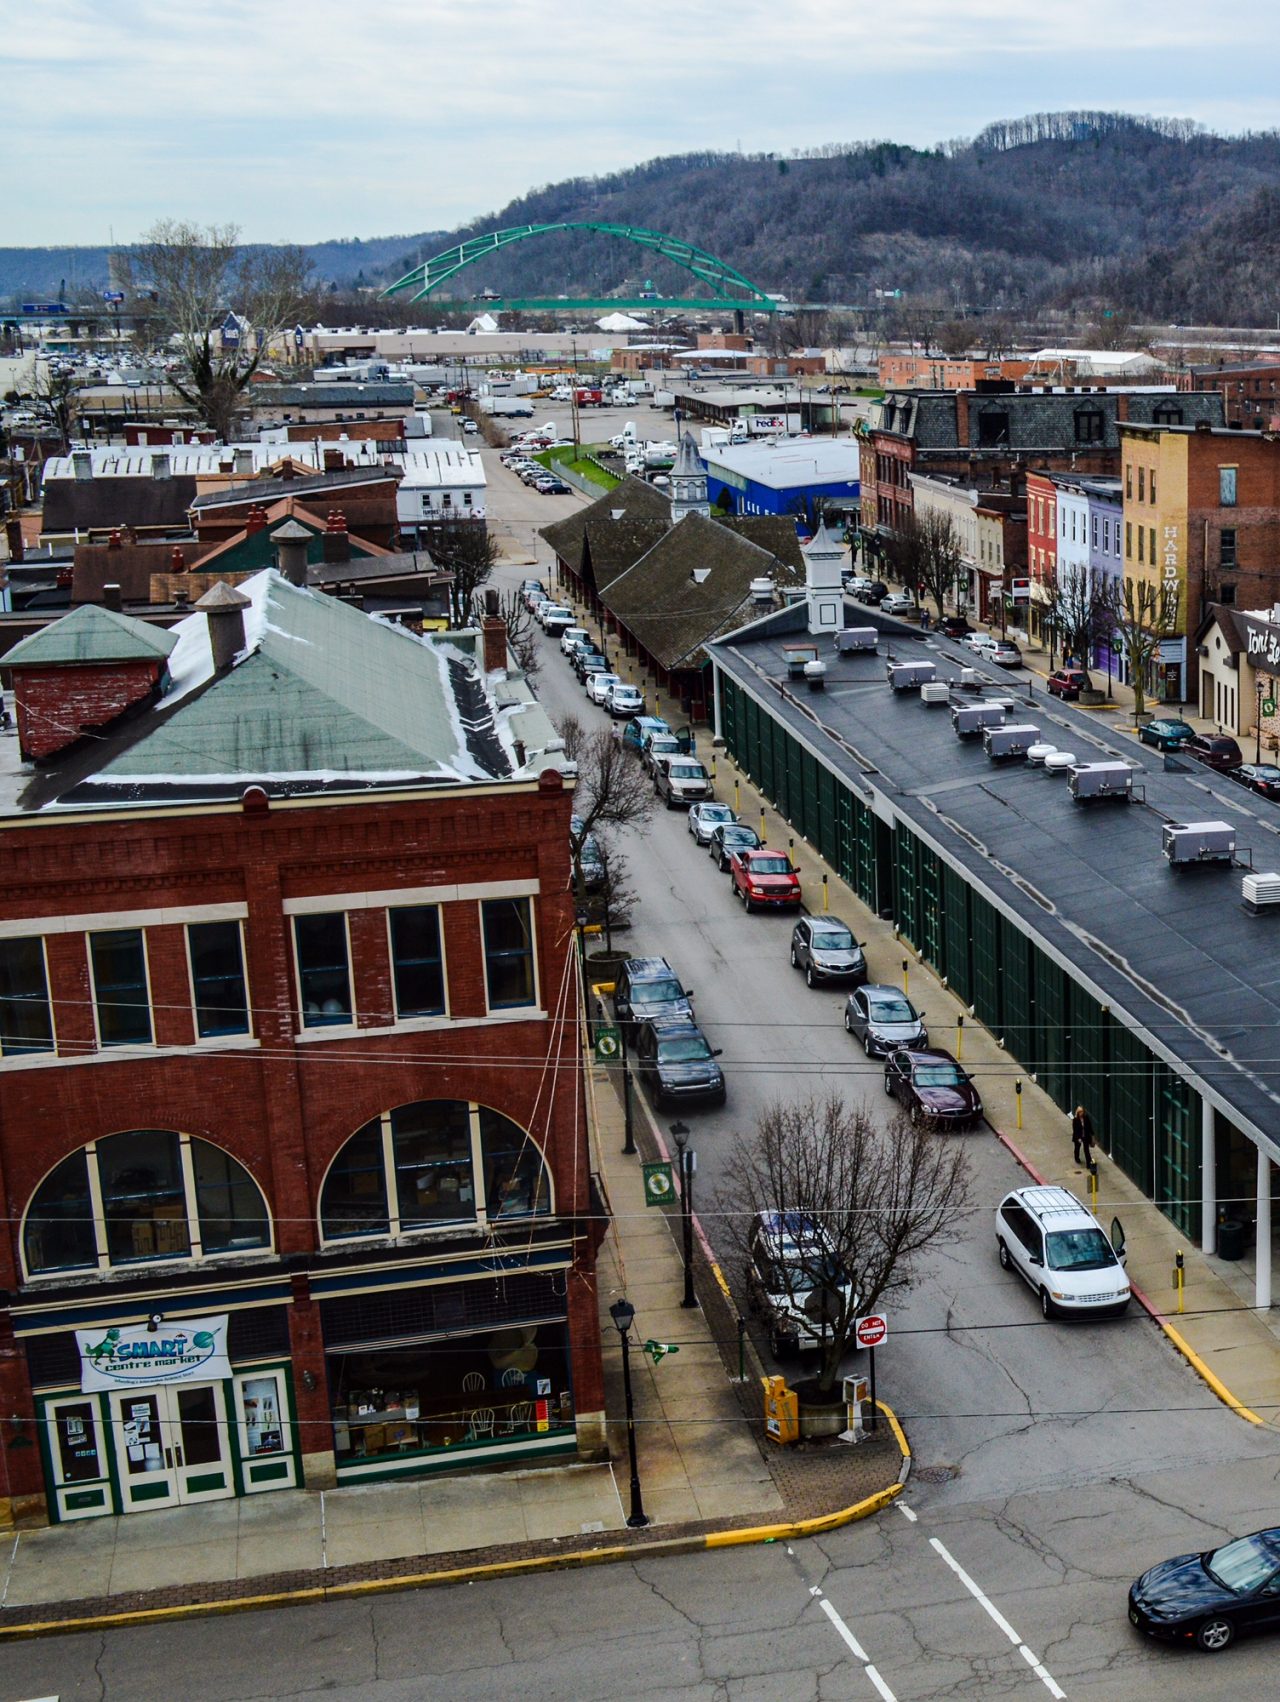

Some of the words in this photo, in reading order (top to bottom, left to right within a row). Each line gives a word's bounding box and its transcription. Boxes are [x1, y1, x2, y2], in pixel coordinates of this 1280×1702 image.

[1246, 625, 1269, 655] Toni
[117, 1336, 188, 1362] SMART
[105, 1361, 152, 1372] centre
[154, 1354, 201, 1367] market
